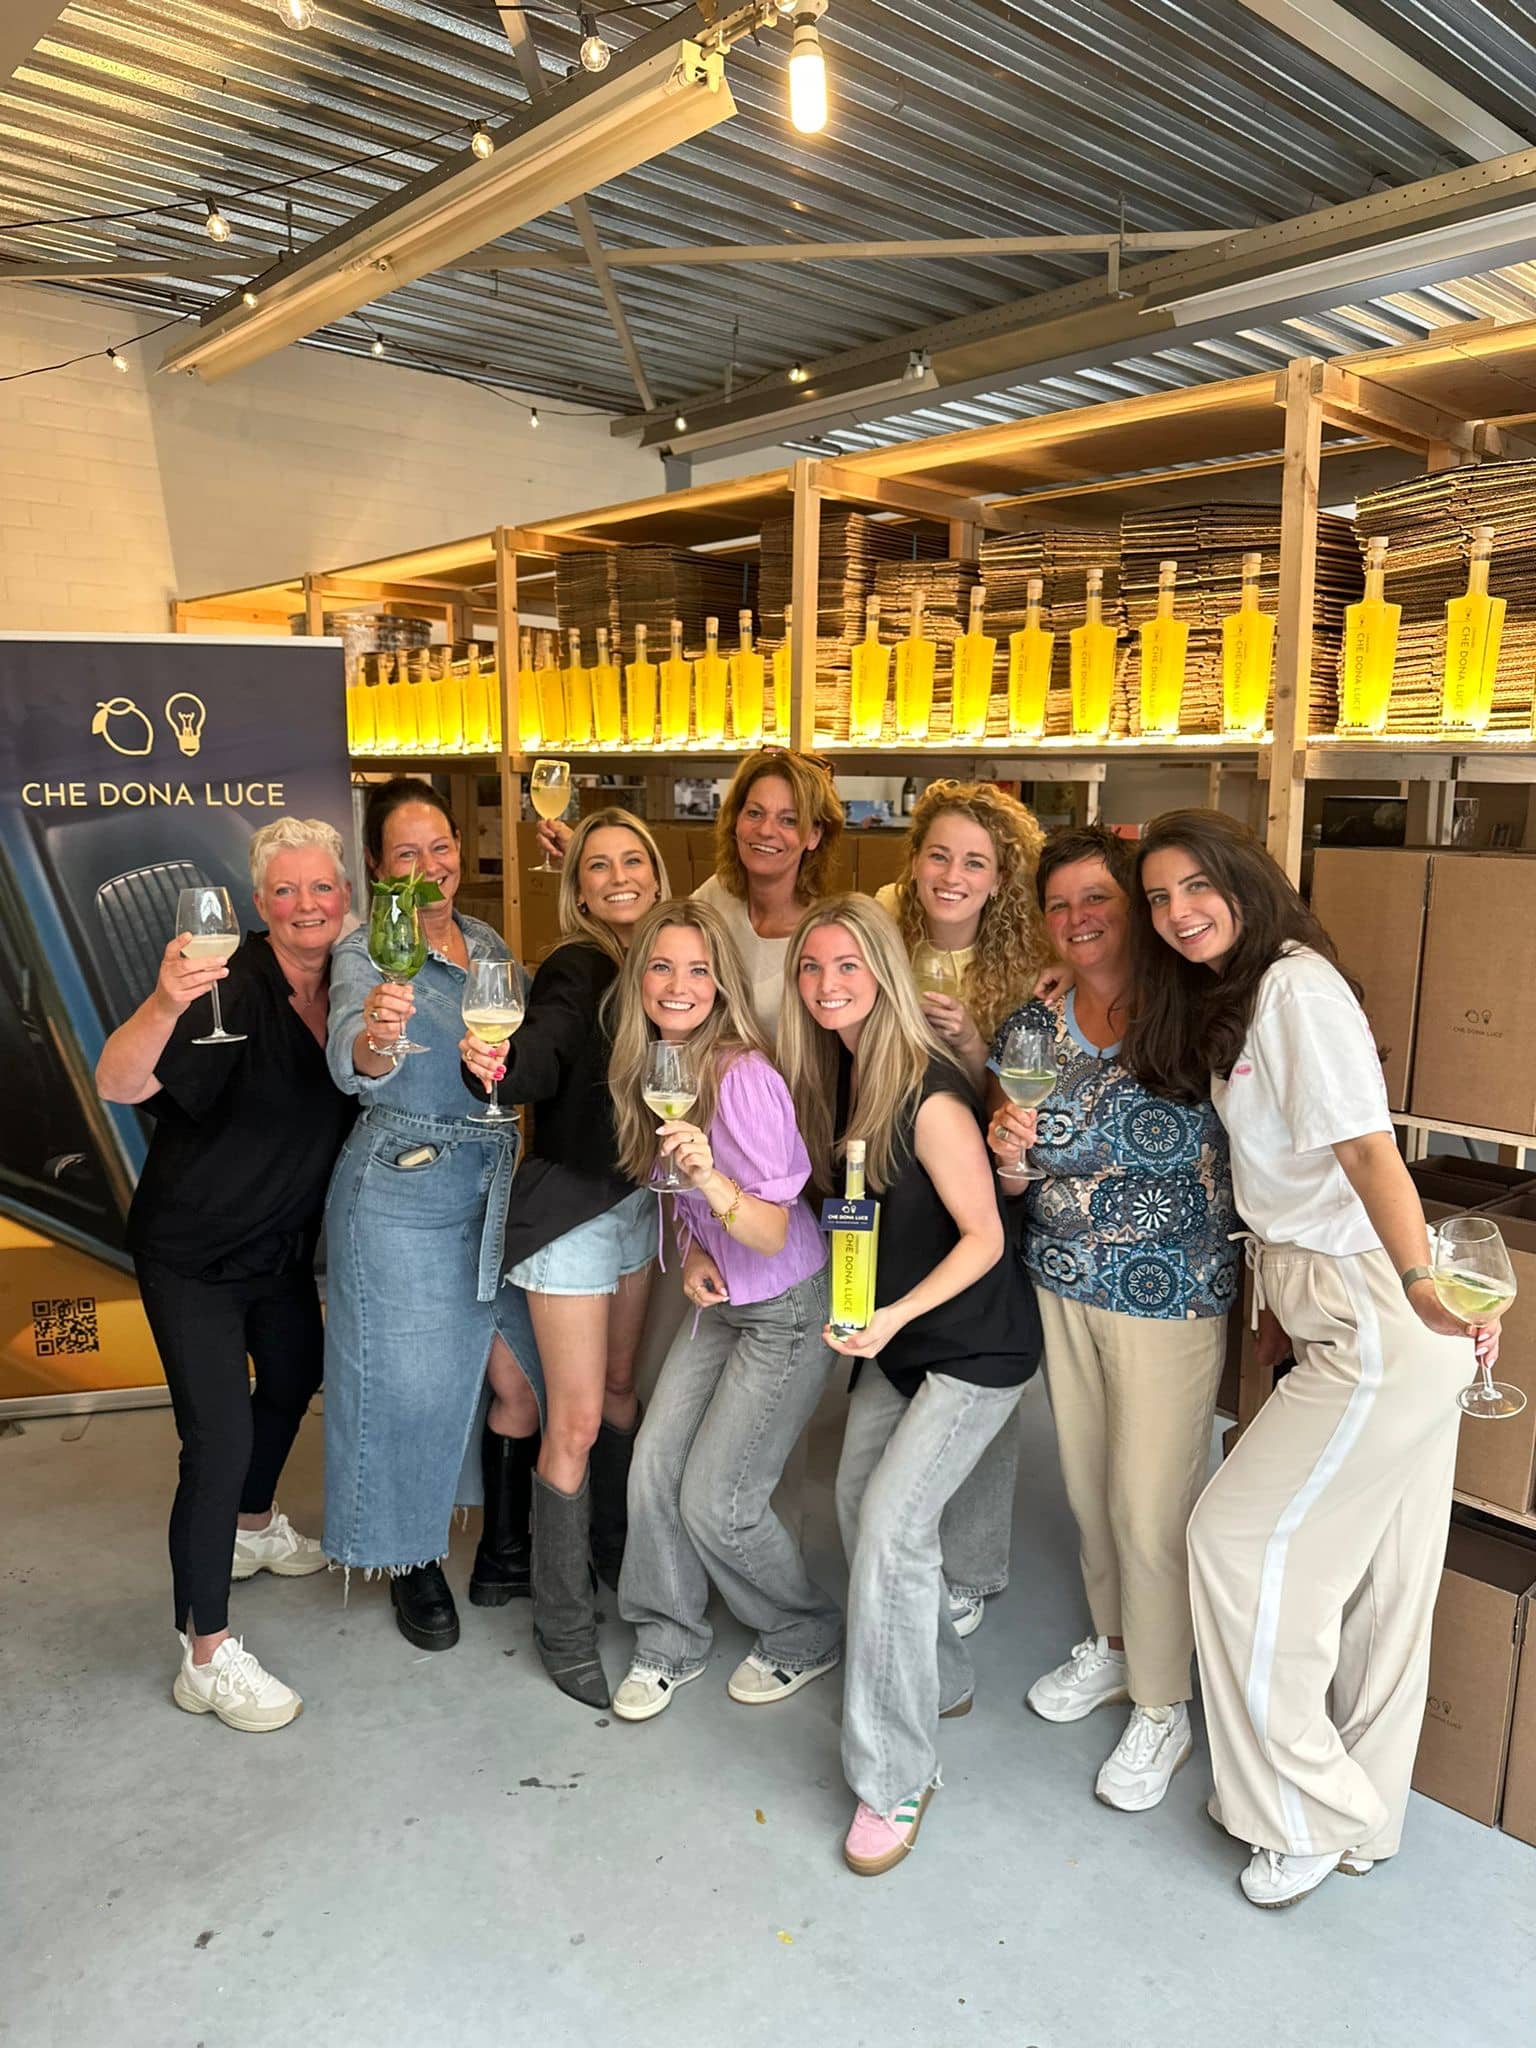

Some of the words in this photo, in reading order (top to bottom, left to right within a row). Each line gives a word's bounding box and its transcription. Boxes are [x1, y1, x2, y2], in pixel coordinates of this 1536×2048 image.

[1356, 632, 1365, 653] CHE
[1461, 626, 1471, 648] CHE
[1355, 655, 1364, 685] DONA
[1458, 650, 1469, 681] DONA
[1456, 683, 1465, 710] LUCE
[21, 782, 88, 807] CHE
[98, 782, 195, 807] DONA
[204, 783, 286, 807] LUCE
[846, 1232, 855, 1253] CHE
[845, 1255, 854, 1285] DONA
[844, 1287, 853, 1313] LUCE
